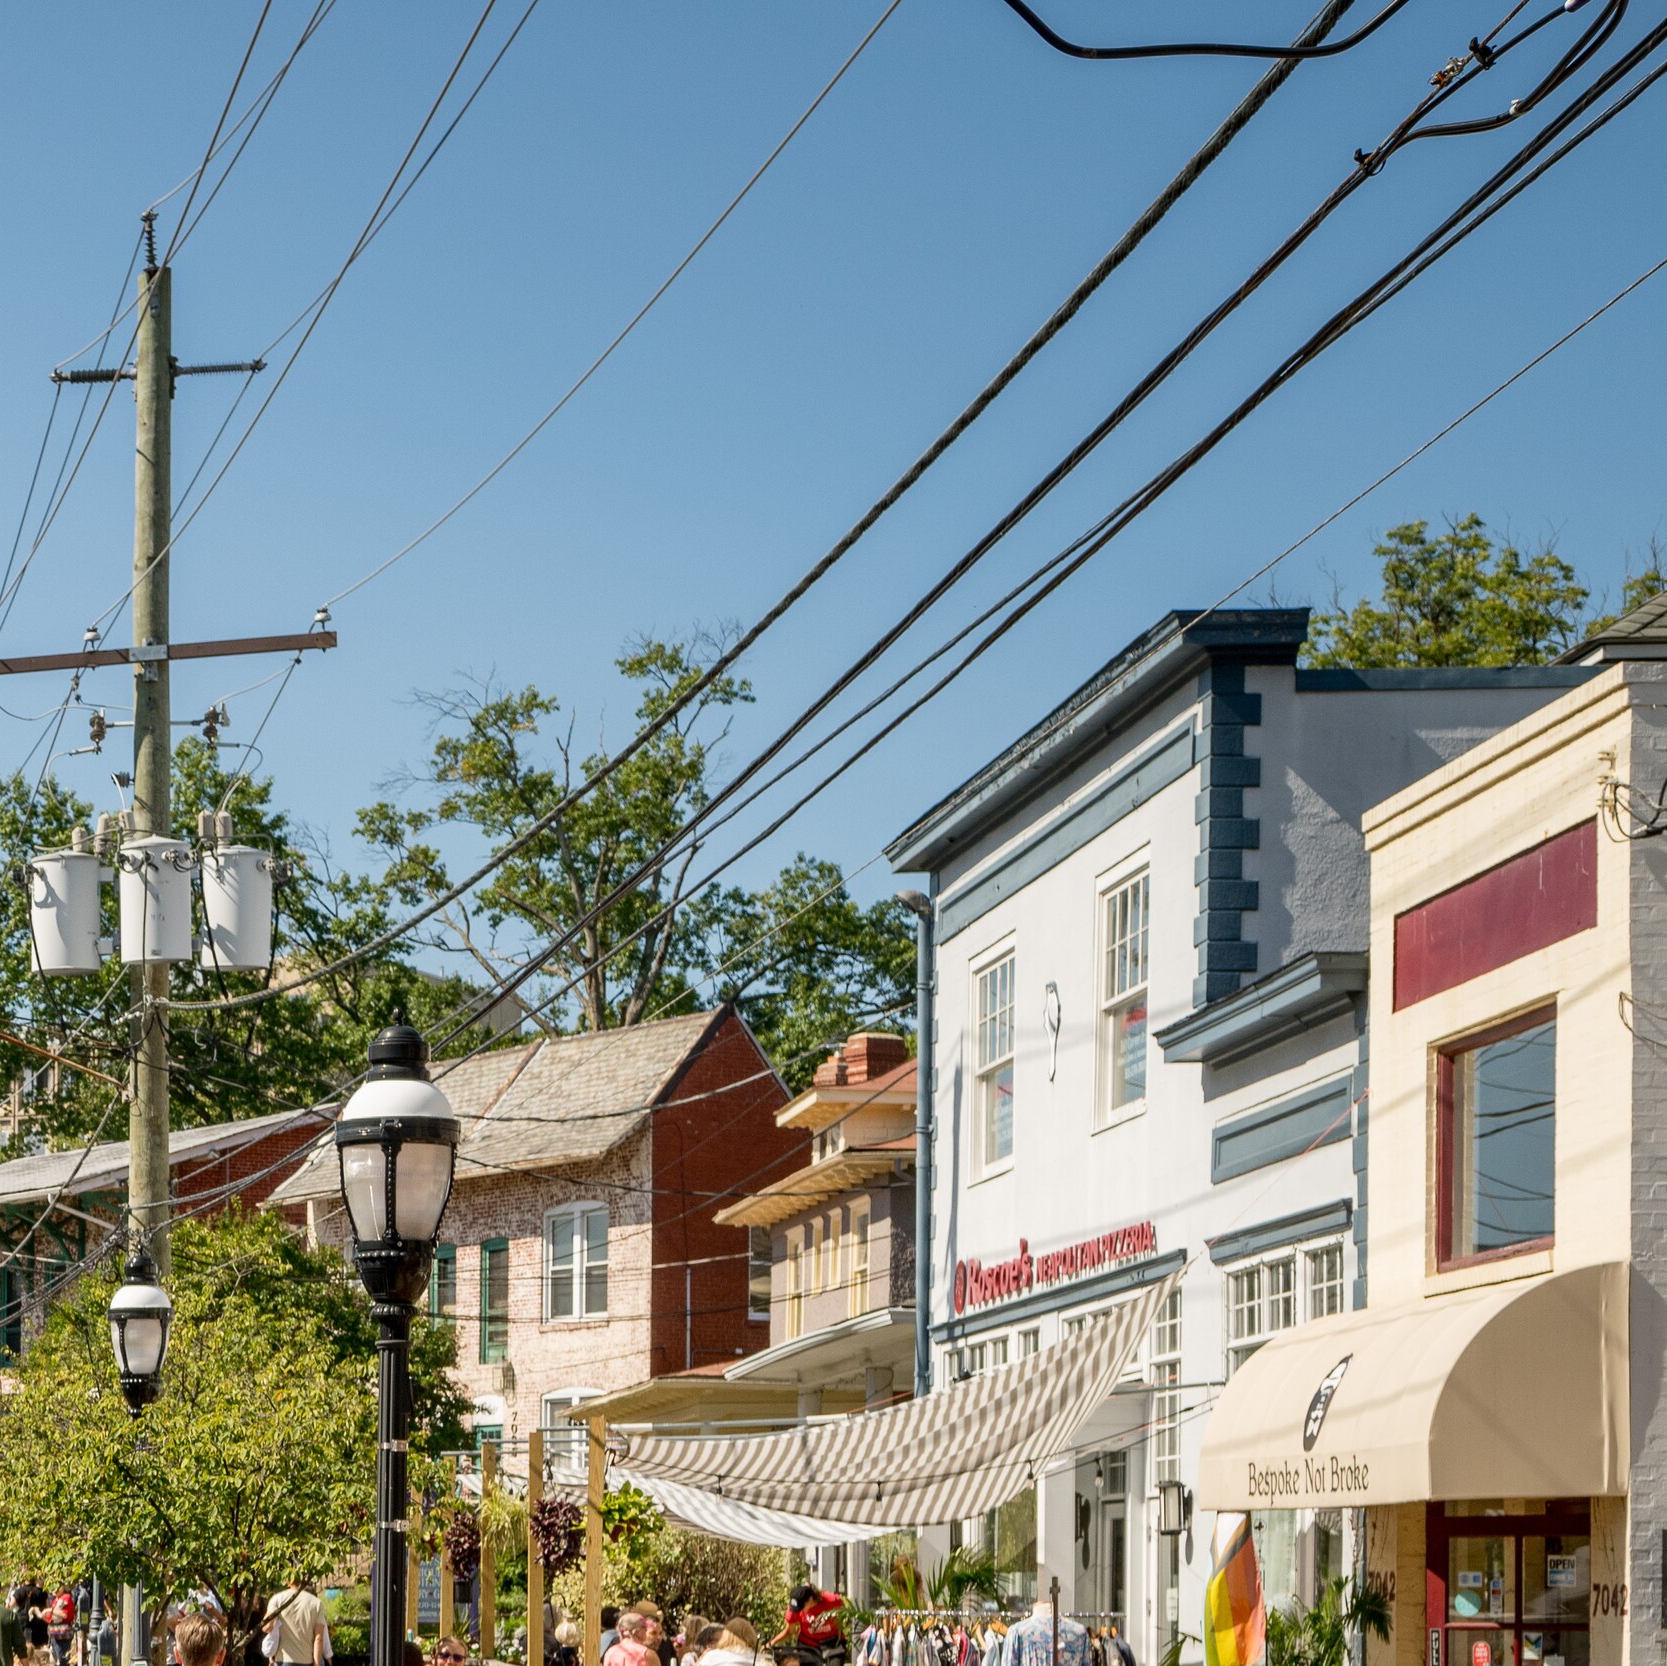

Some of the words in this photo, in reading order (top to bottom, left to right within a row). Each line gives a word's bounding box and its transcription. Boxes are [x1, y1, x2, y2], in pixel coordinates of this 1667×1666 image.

[968, 1238, 1033, 1305] Roscoe's
[1036, 1237, 1102, 1283] NEAPOLITAN
[1102, 1221, 1155, 1264] PIZZERIA
[1248, 1460, 1300, 1506] Bespoke
[1305, 1457, 1326, 1494] Not
[1330, 1454, 1369, 1492] Broke
[1549, 1558, 1575, 1569] OPEN
[1593, 1583, 1628, 1617] 7042
